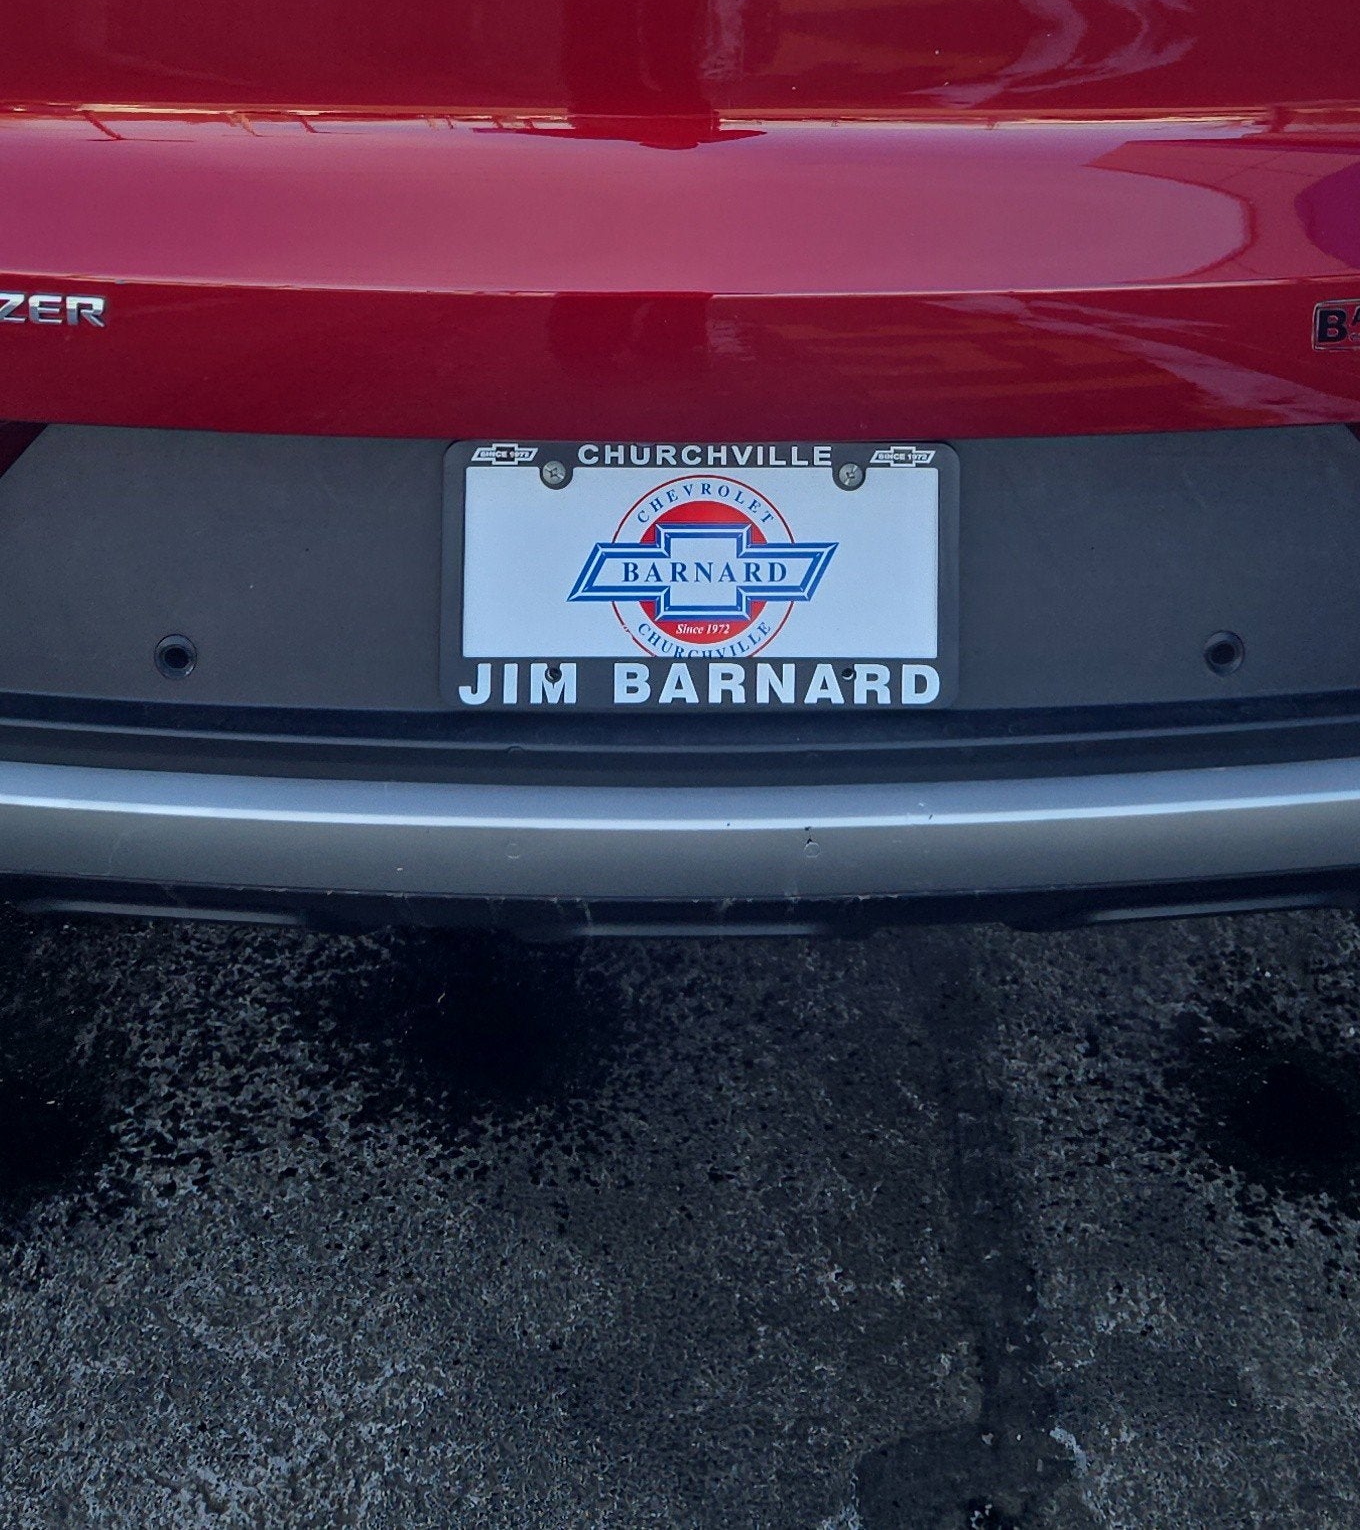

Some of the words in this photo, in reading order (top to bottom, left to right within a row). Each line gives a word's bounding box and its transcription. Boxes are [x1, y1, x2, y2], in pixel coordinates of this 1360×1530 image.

[577, 444, 832, 466] CHURCHVILLE
[878, 453, 906, 461] SINCE
[636, 482, 775, 525] CHEVROLET
[621, 561, 787, 583] BARNARD
[638, 621, 771, 658] CHURCHVILLE
[675, 623, 704, 635] Since
[706, 623, 731, 635] 1972
[458, 662, 578, 705] JIM
[613, 662, 940, 706] BARNARD
